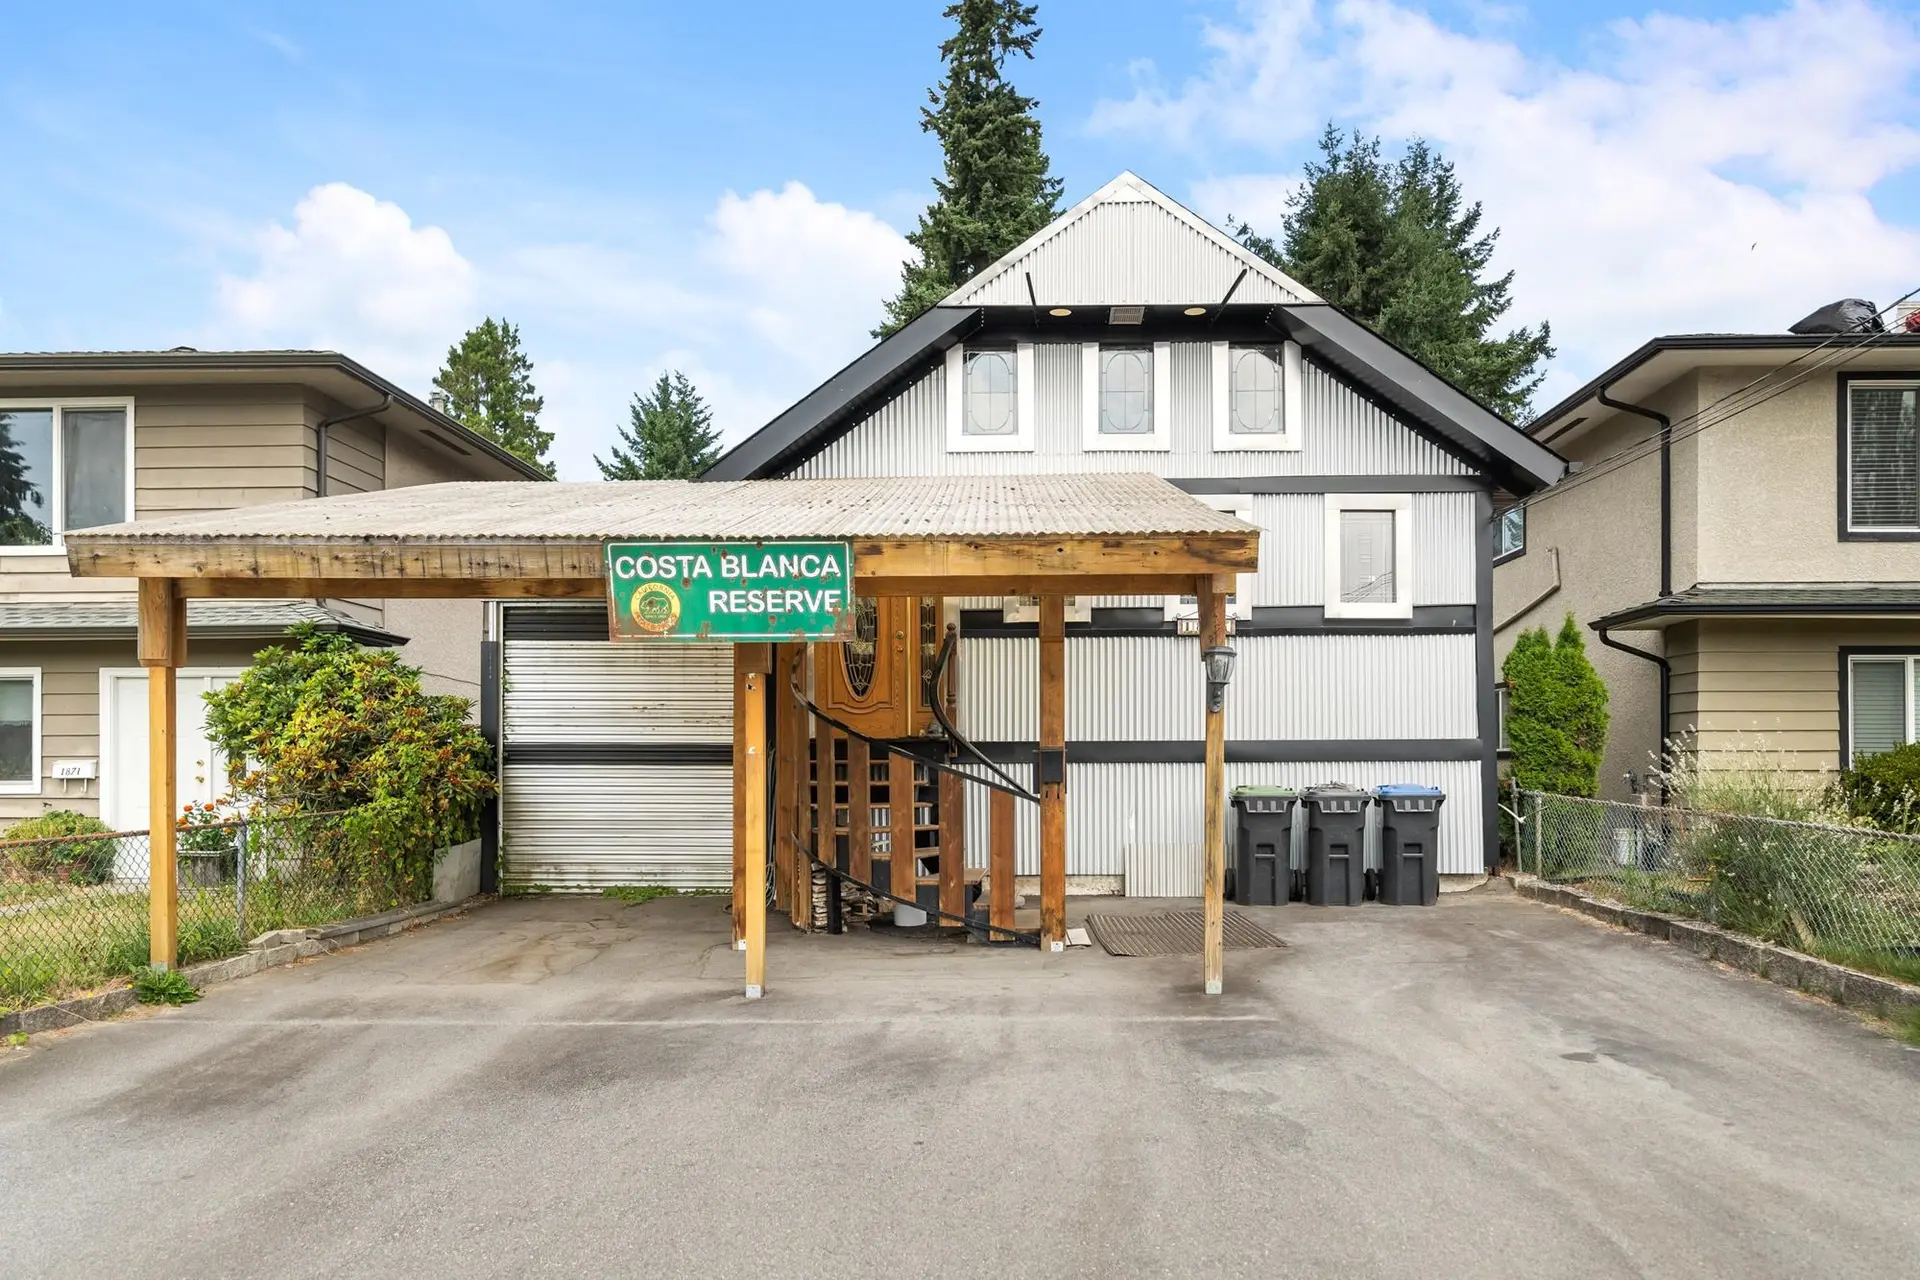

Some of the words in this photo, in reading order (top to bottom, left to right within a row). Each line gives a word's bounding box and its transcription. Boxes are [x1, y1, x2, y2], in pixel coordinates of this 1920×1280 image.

[615, 555, 713, 579] COSTA
[721, 554, 841, 578] BLANCA
[709, 590, 841, 613] RESERVE
[60, 767, 81, 776] 1871
